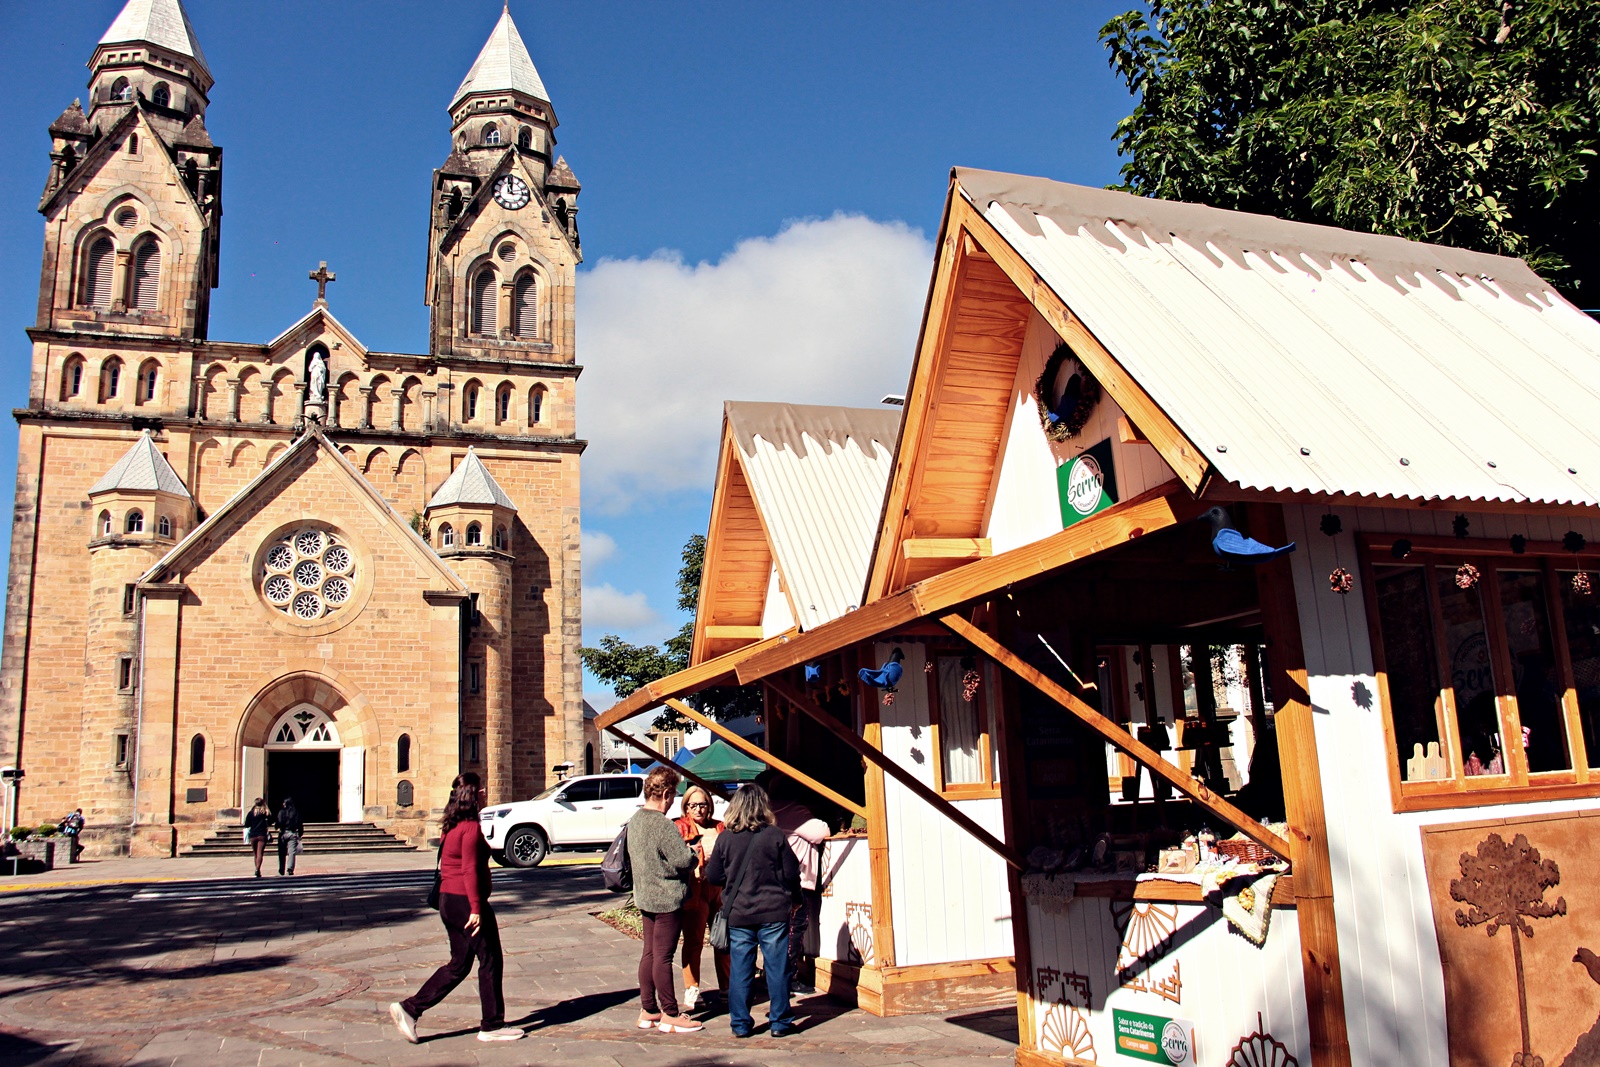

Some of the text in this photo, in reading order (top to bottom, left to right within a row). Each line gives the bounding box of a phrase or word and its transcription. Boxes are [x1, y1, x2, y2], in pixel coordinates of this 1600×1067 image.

[1118, 1016, 1128, 1026] Sabor
[1118, 1024, 1129, 1034] Serra
[1130, 1027, 1155, 1039] Catarinense
